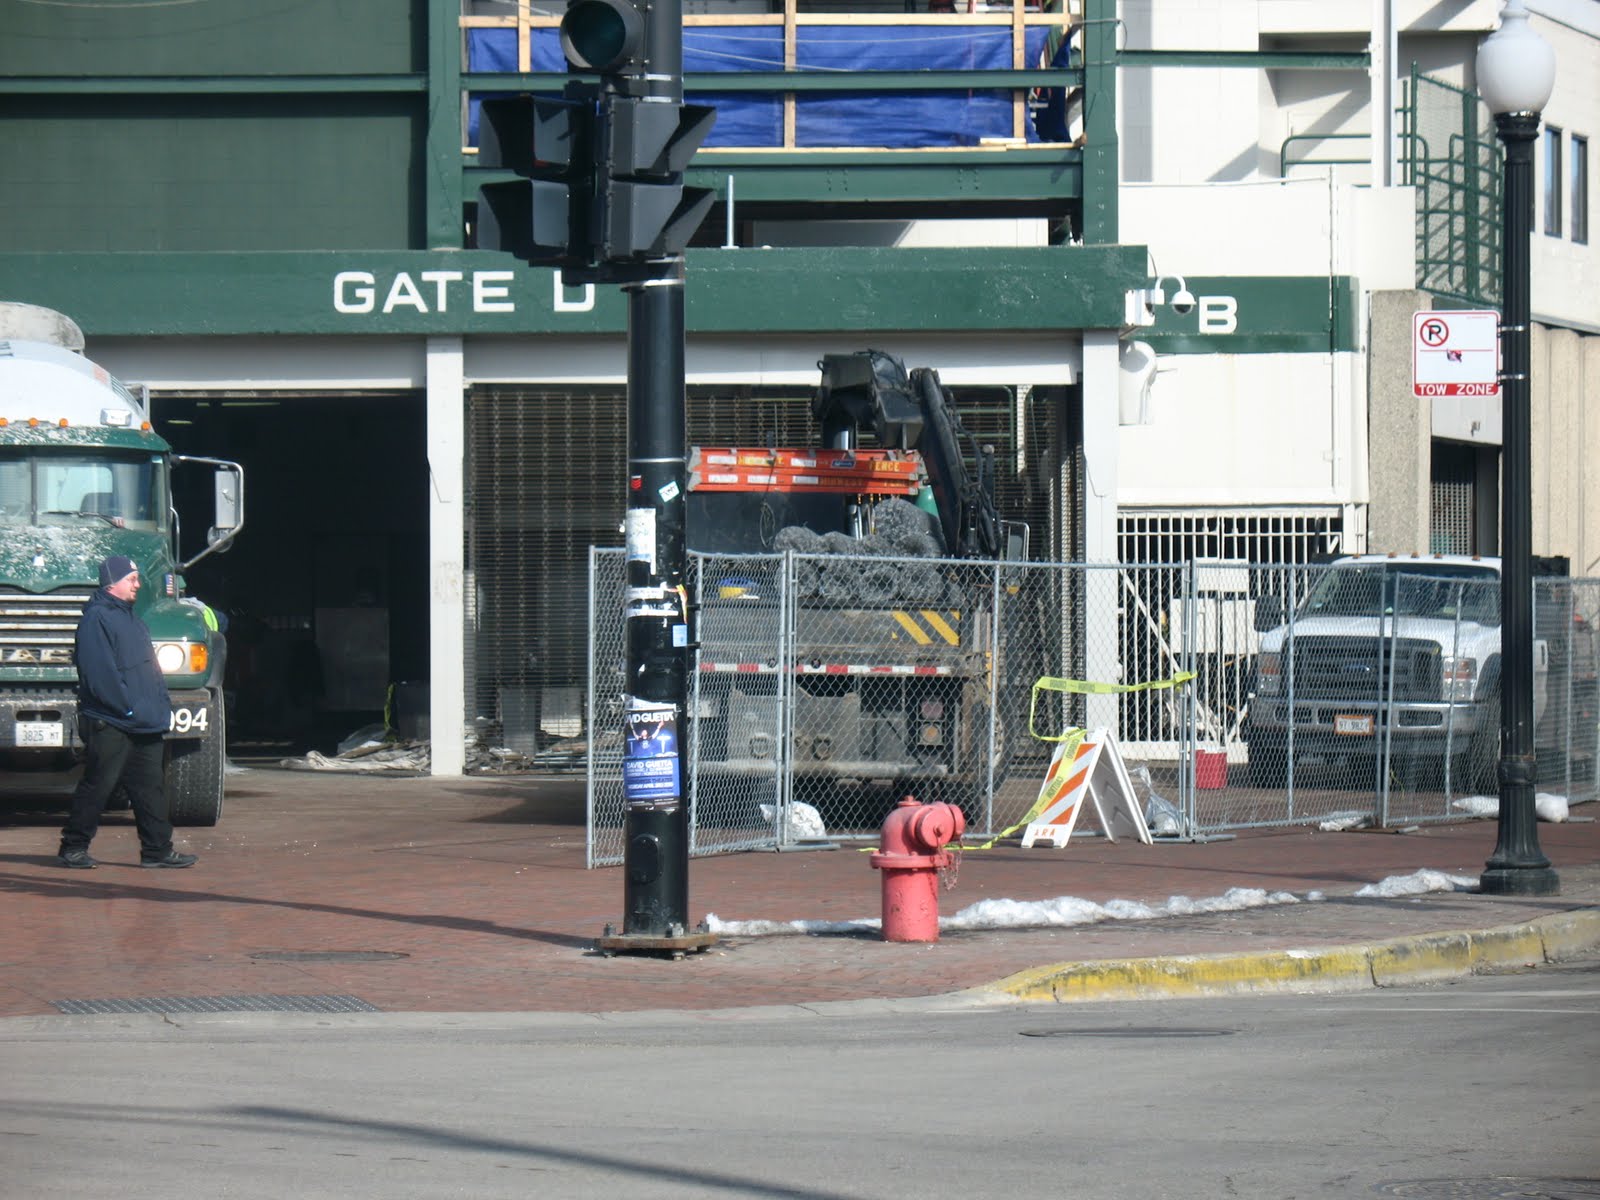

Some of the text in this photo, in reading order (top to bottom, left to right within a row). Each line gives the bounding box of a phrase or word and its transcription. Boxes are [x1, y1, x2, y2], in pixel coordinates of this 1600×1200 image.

[333, 271, 515, 313] GATE
[1199, 296, 1238, 334] B
[1418, 384, 1495, 395] TOW ZONE
